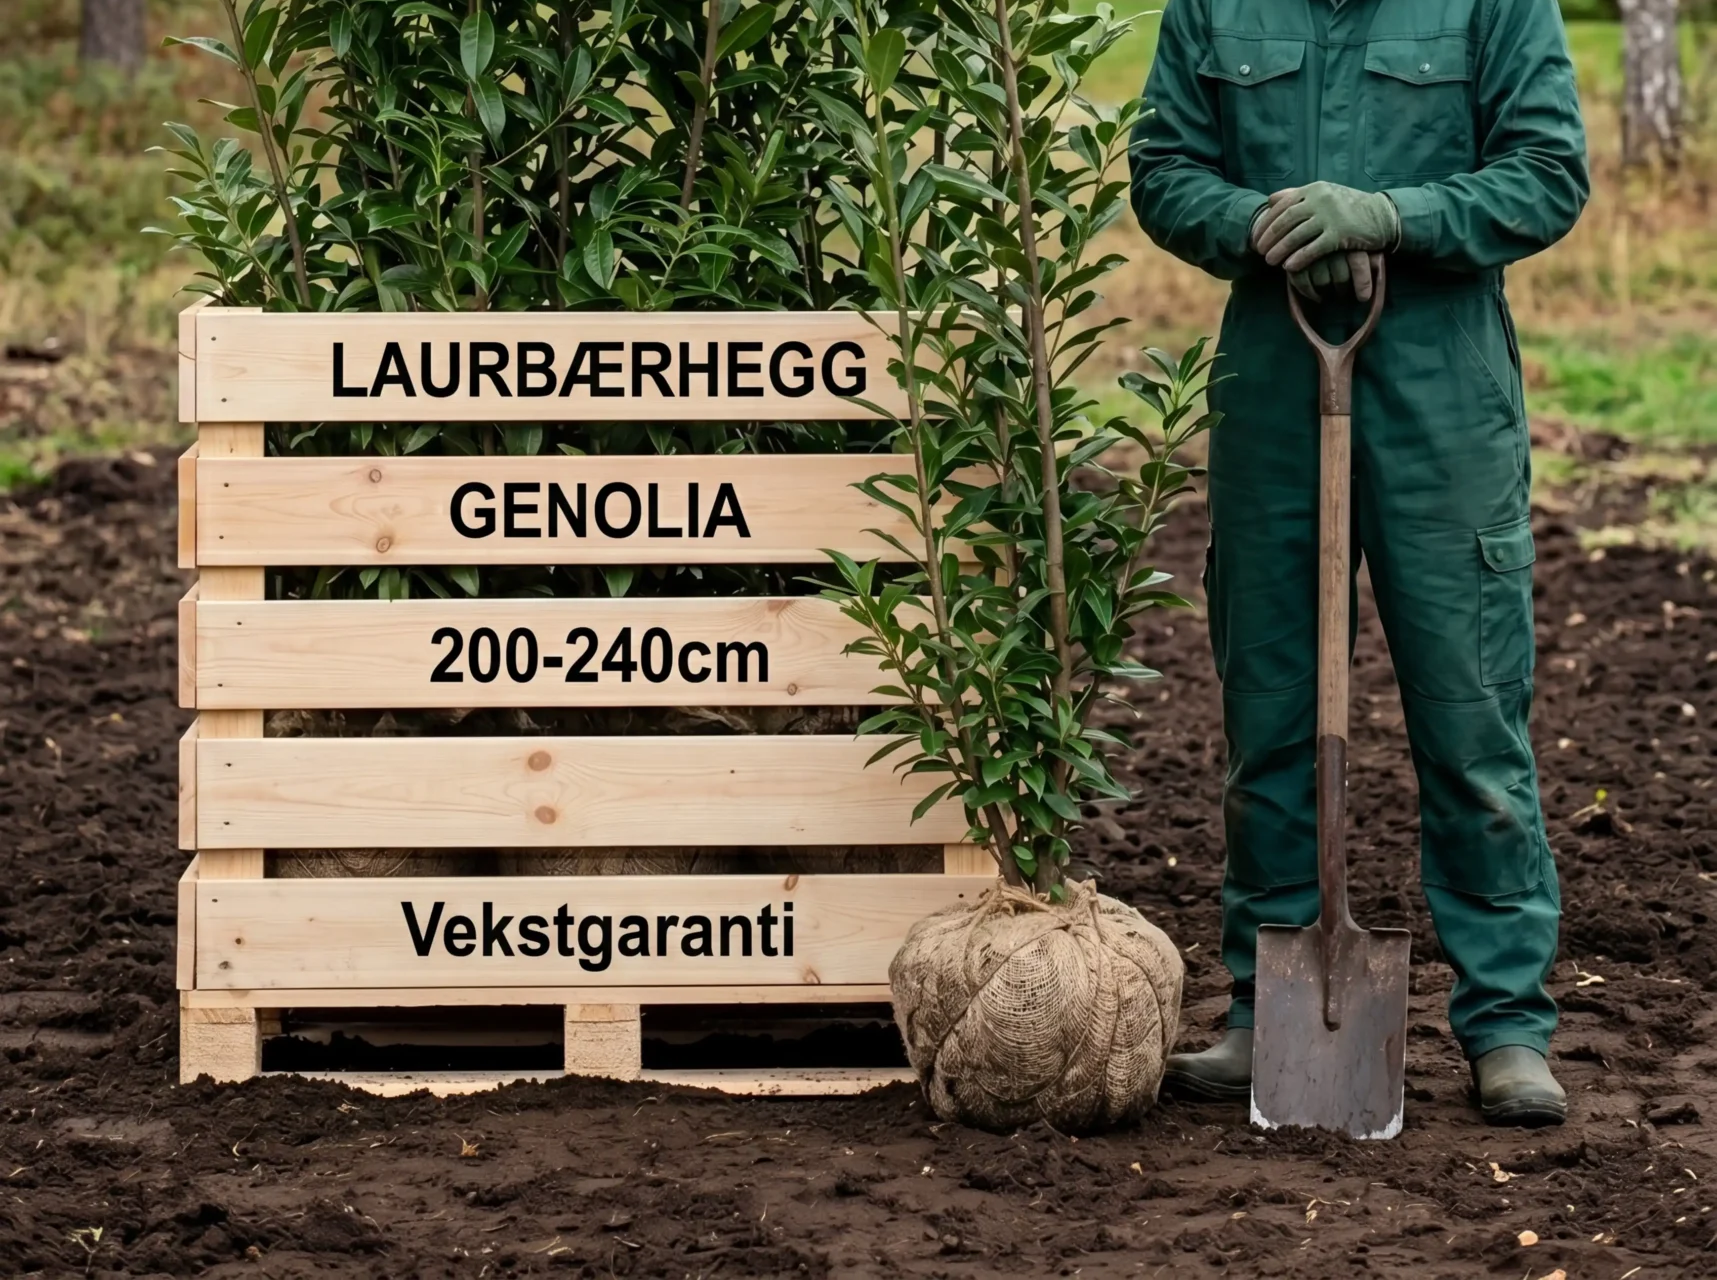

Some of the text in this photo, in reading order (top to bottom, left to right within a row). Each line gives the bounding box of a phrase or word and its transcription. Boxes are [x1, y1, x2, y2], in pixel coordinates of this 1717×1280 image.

[332, 341, 867, 399] LAURBÆRHEGG
[450, 481, 752, 539] GENOLIA
[430, 626, 769, 684] 200-240cm
[400, 901, 794, 973] Vekstgaranti
